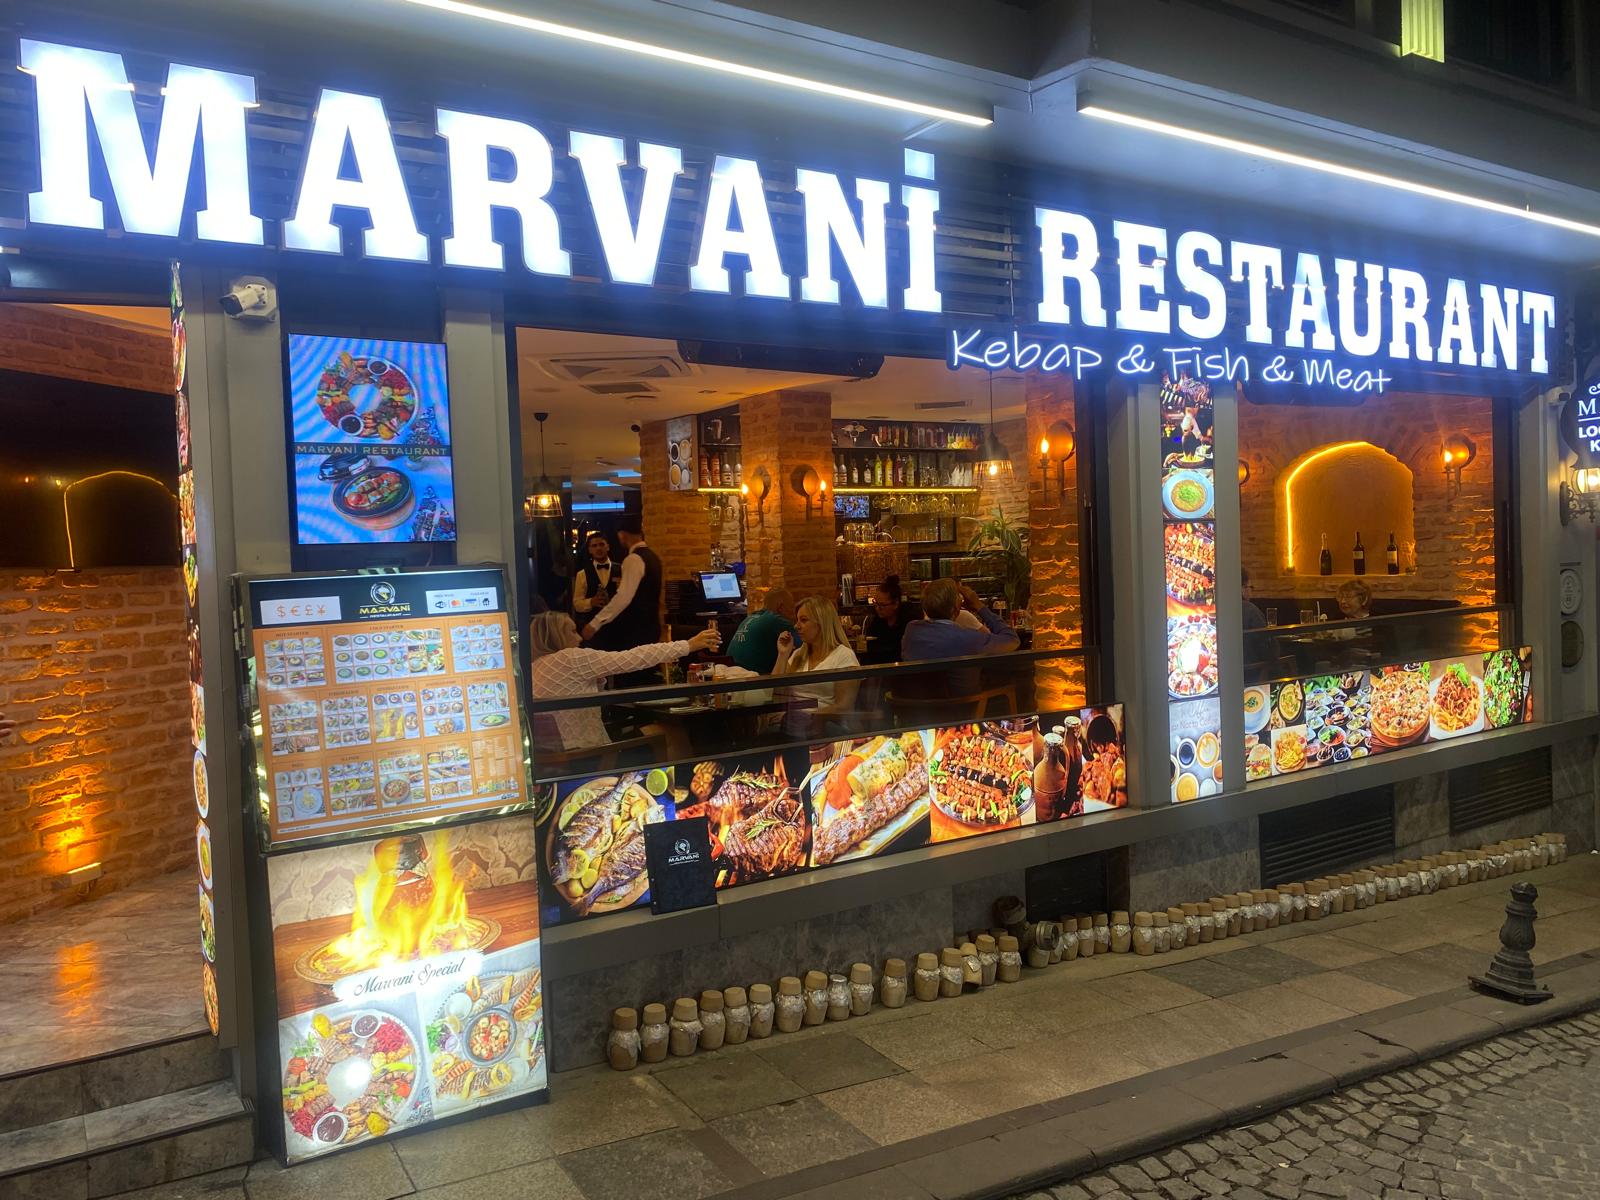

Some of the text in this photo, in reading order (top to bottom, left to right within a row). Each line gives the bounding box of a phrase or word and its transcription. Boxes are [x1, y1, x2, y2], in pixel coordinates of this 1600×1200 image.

[1034, 206, 1556, 375] RESTAURANT
[951, 328, 1393, 394] Kebap & Fish & Meat
[1577, 398, 1600, 416] M
[1578, 425, 1600, 439] LO
[362, 446, 447, 456] RESTAURANT
[417, 956, 466, 986] Special
